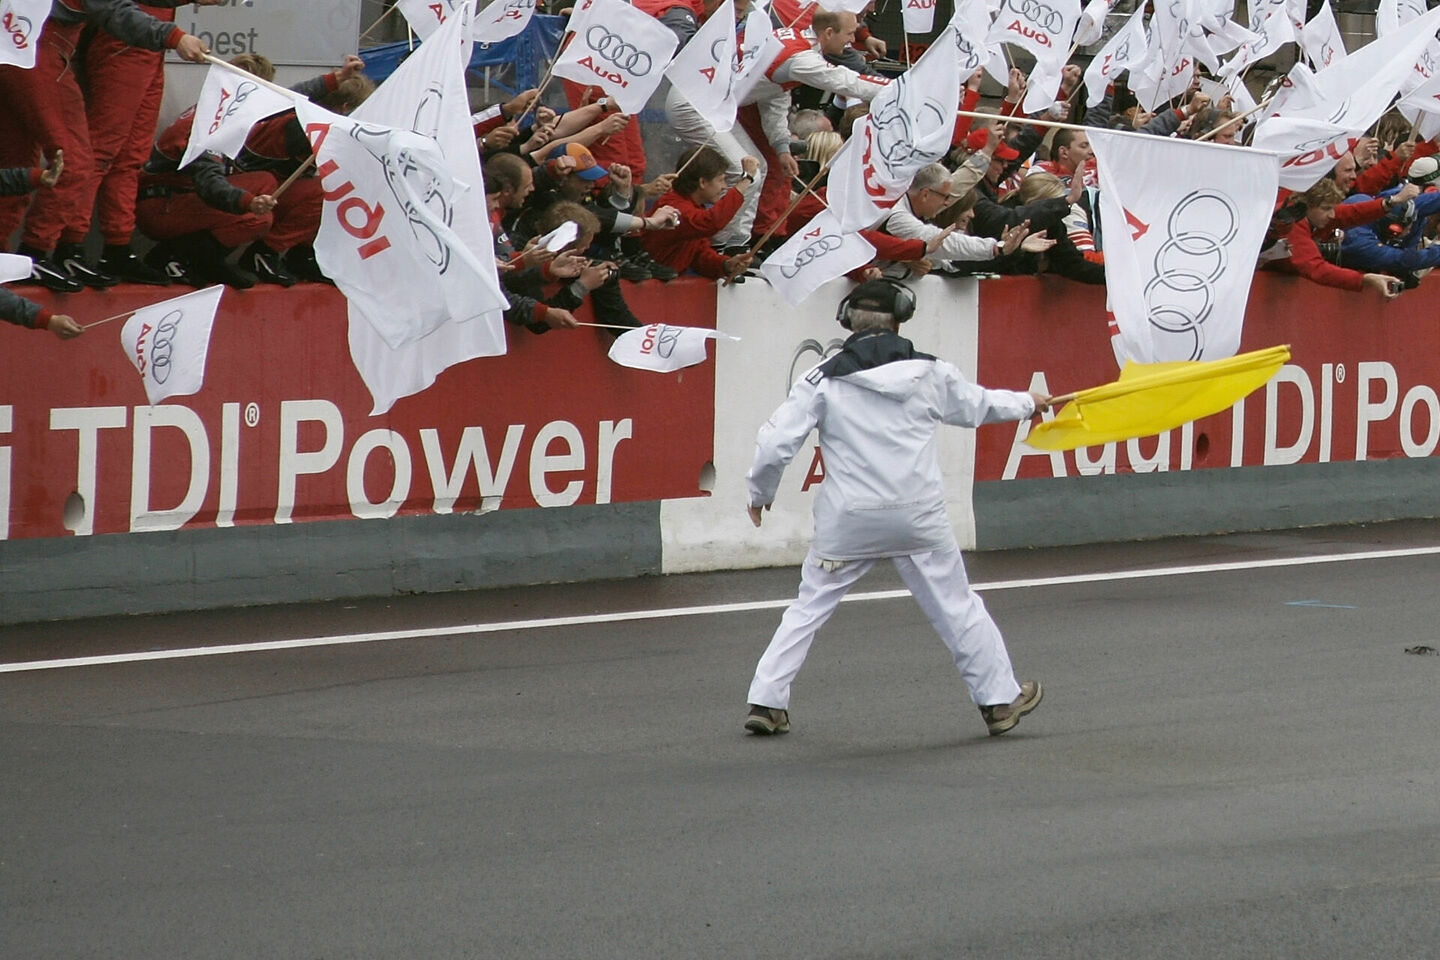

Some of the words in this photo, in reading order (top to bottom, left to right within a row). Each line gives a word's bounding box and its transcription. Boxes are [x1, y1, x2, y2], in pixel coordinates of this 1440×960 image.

[1007, 20, 1053, 48] Audi
[577, 56, 628, 88] Audi
[306, 122, 392, 261] Audi
[135, 322, 154, 378] Audi
[274, 399, 633, 525] Power
